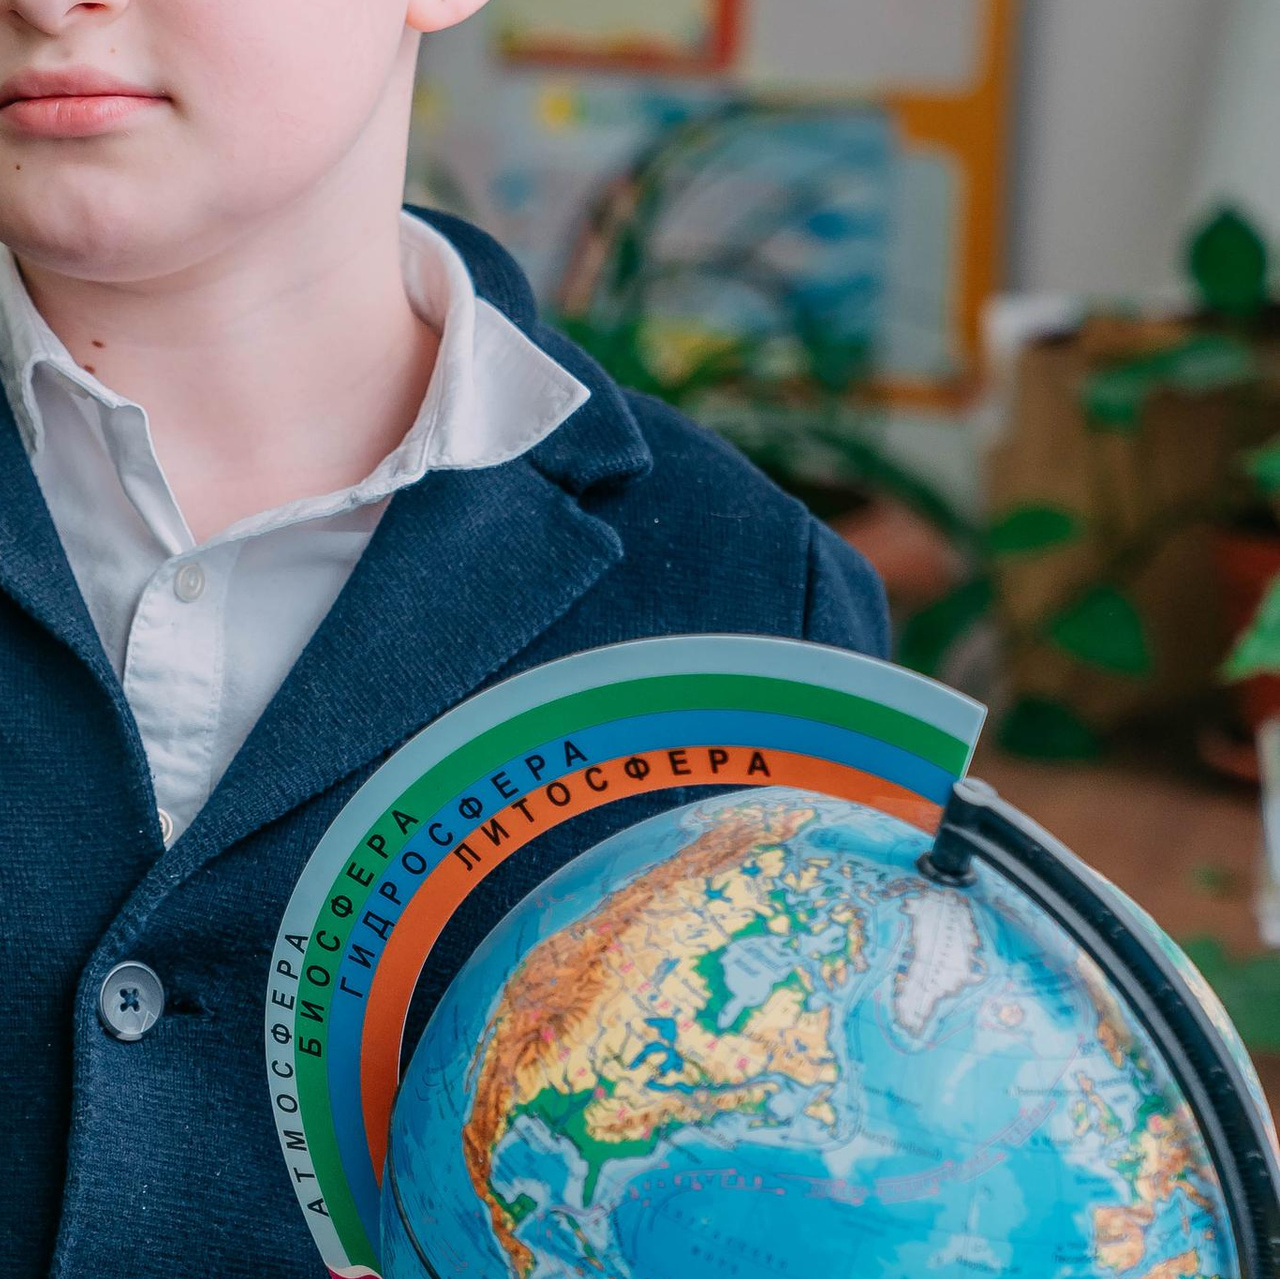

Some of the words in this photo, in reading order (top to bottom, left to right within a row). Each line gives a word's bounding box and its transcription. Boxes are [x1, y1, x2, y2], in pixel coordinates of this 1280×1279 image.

[299, 809, 420, 1058] БИОСФЕРА
[340, 740, 589, 998] ГИДРОСФЕРА
[454, 748, 771, 872] ЛИТОСФЕРА
[270, 932, 330, 1217] АТМОСФЕРА
